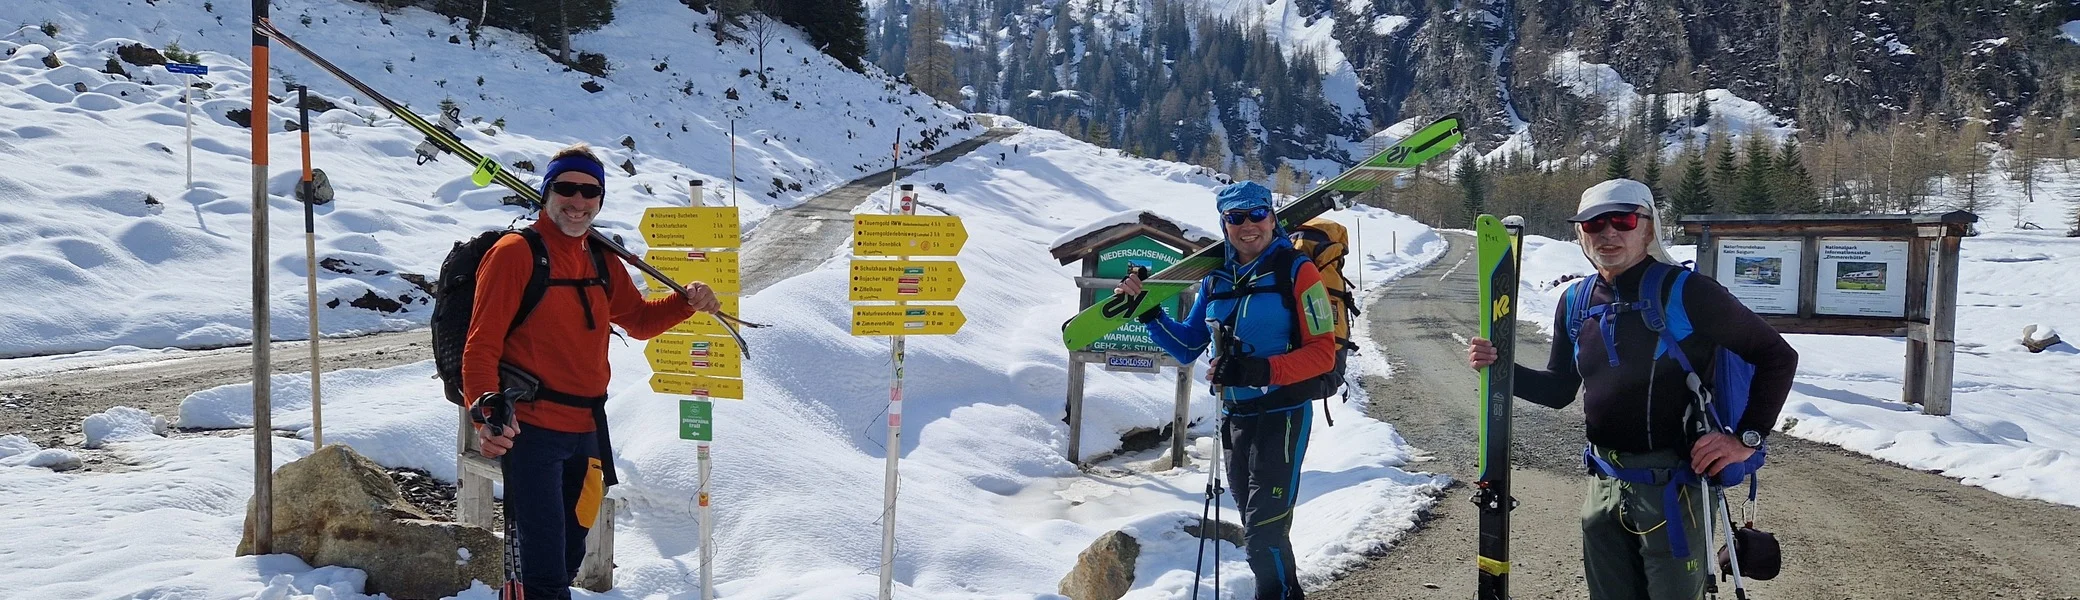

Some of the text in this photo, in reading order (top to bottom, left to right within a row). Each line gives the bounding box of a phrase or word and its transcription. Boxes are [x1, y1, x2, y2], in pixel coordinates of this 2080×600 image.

[1386, 146, 1413, 164] K2
[1101, 290, 1150, 319] K2
[1493, 294, 1510, 322] K2
[1117, 323, 1148, 333] NÄCHT
[1104, 333, 1154, 344] WARMWASS
[1110, 357, 1153, 367] GESCHLOSSEN
[1493, 403, 1503, 417] 88
